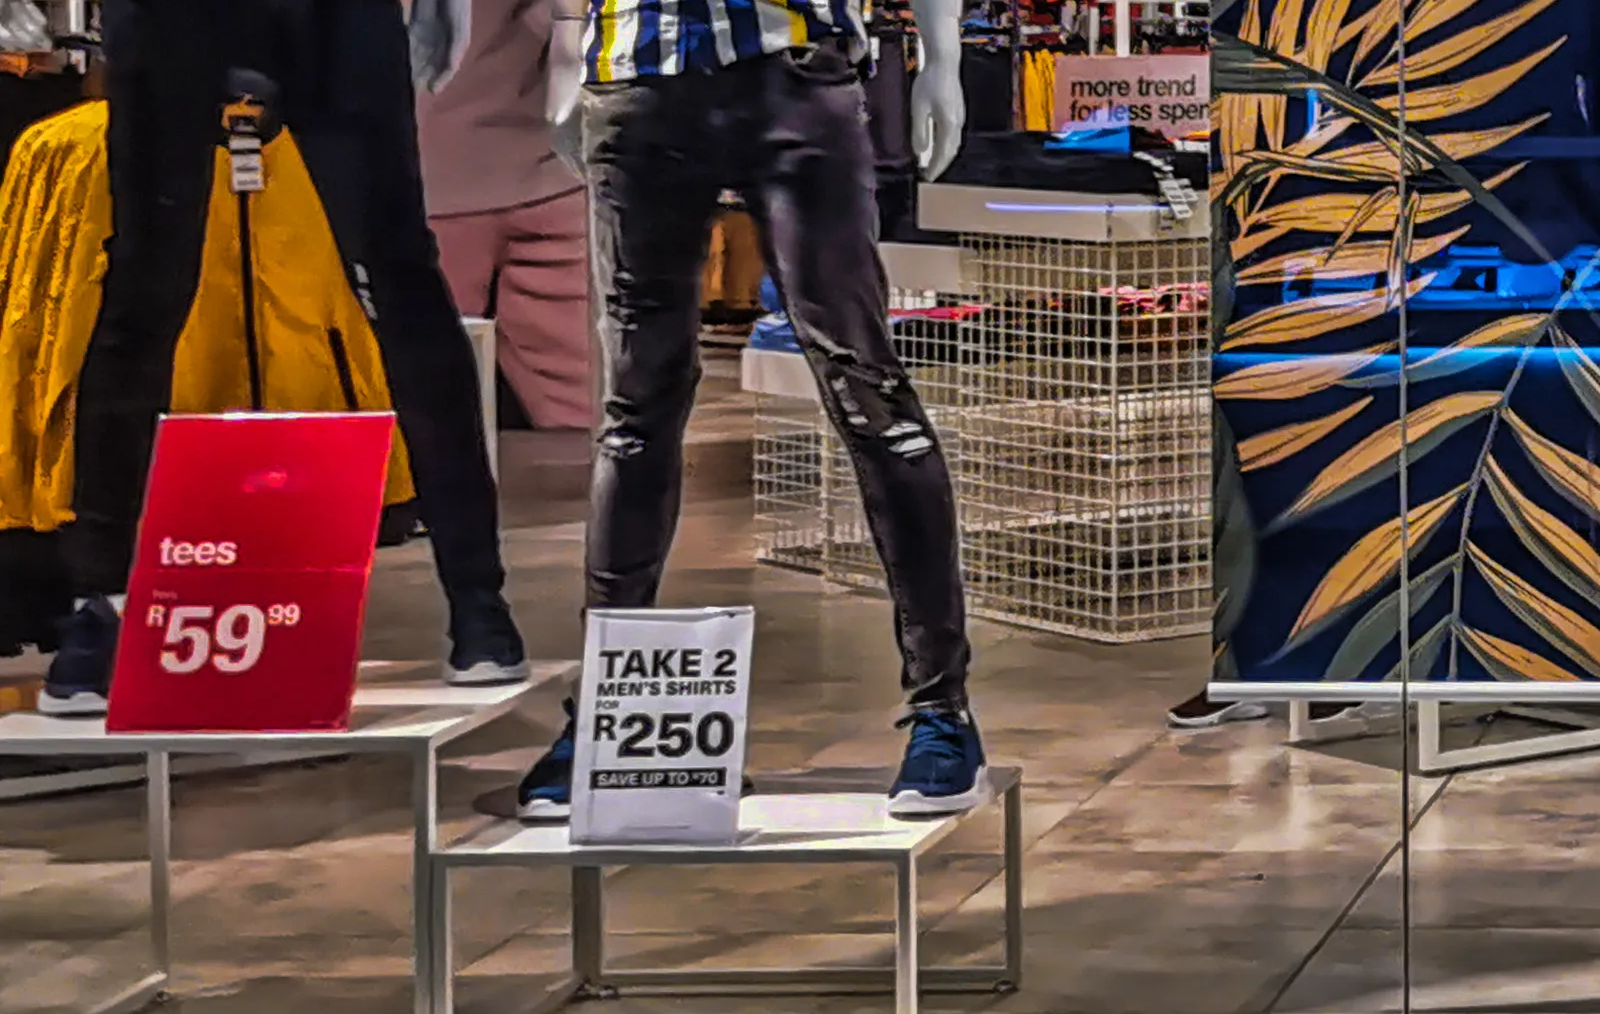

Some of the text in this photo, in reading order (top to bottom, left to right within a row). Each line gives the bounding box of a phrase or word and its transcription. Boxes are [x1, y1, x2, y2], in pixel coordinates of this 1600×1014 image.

[1070, 74, 1196, 97] more trend
[1069, 100, 1102, 122] for
[1107, 100, 1152, 122] less
[159, 536, 239, 567] tees
[598, 648, 737, 680] TAKE 2
[596, 679, 737, 698] MEN'S SHIRTS
[595, 699, 620, 711] FOR
[592, 710, 735, 759] R250
[597, 772, 640, 787] SAVE
[642, 771, 665, 786] UP
[667, 771, 690, 785] TO
